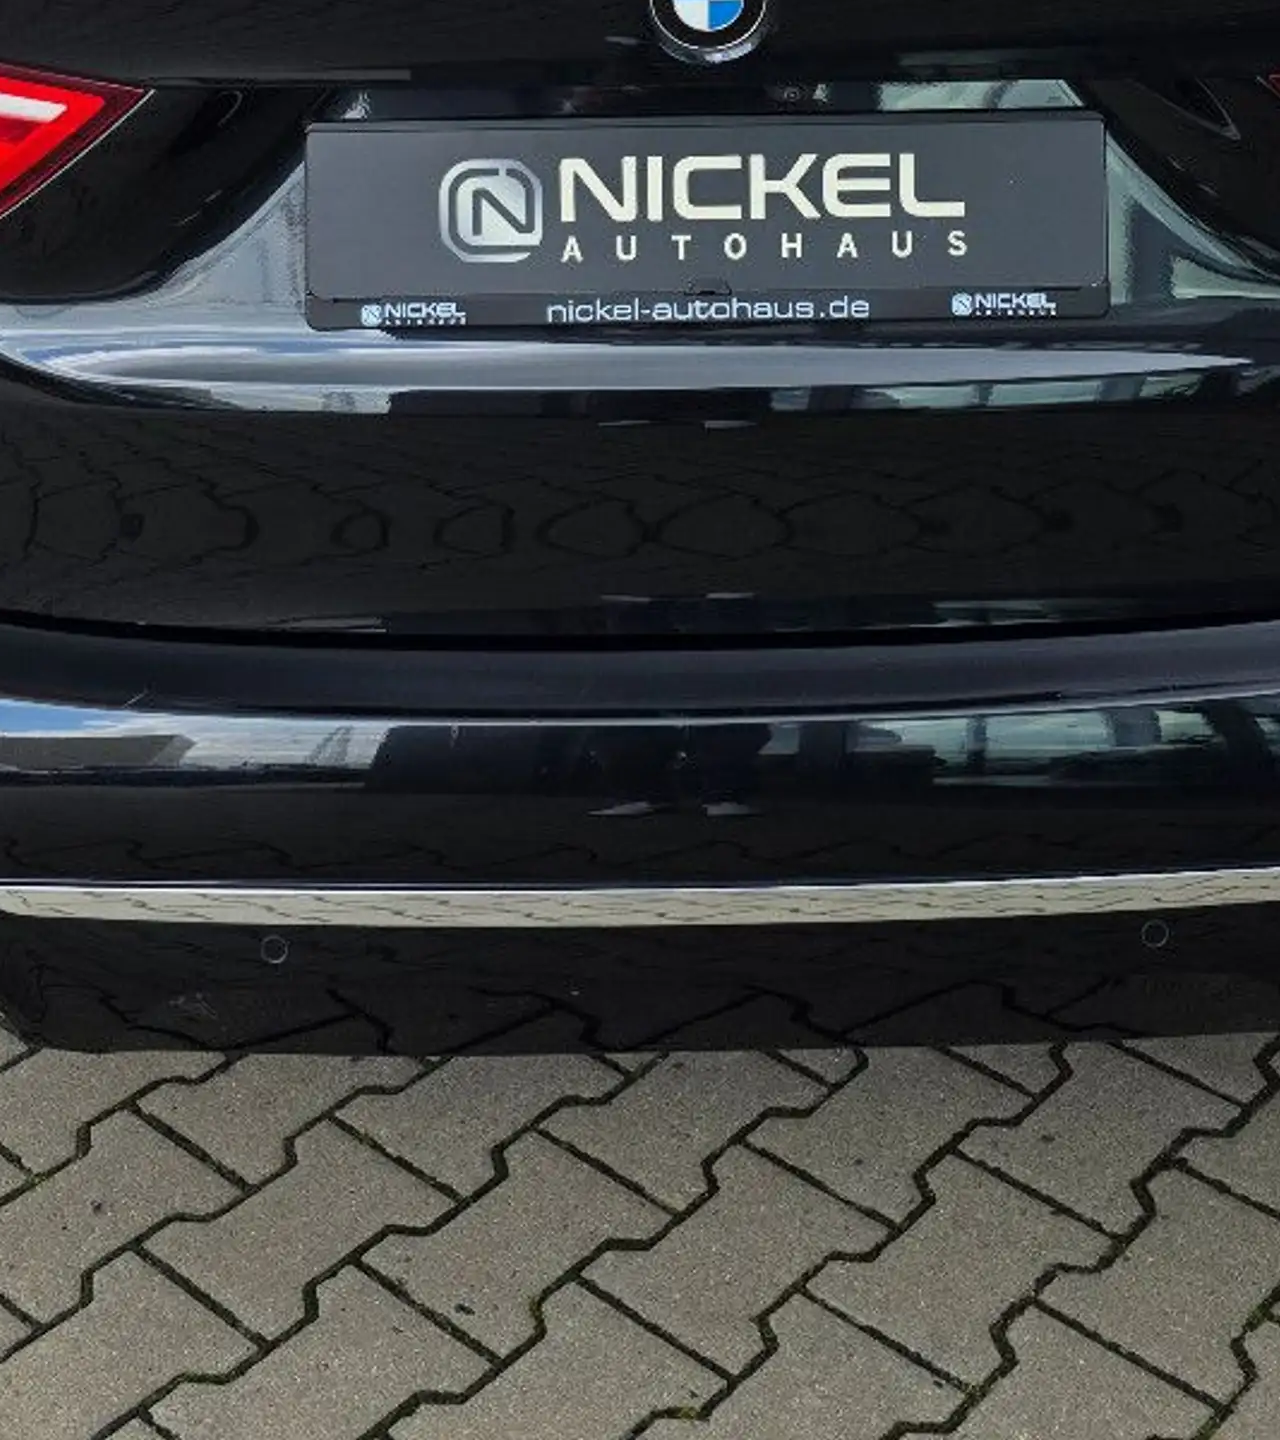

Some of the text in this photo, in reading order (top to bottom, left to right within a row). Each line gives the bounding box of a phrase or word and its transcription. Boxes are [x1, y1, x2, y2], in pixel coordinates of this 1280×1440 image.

[558, 152, 966, 222] NICKEL
[560, 230, 969, 264] AUTOHAUS
[384, 301, 467, 319] NICKEL
[546, 295, 871, 323] nickel-autohaus.de
[974, 292, 1057, 309] NICKEL
